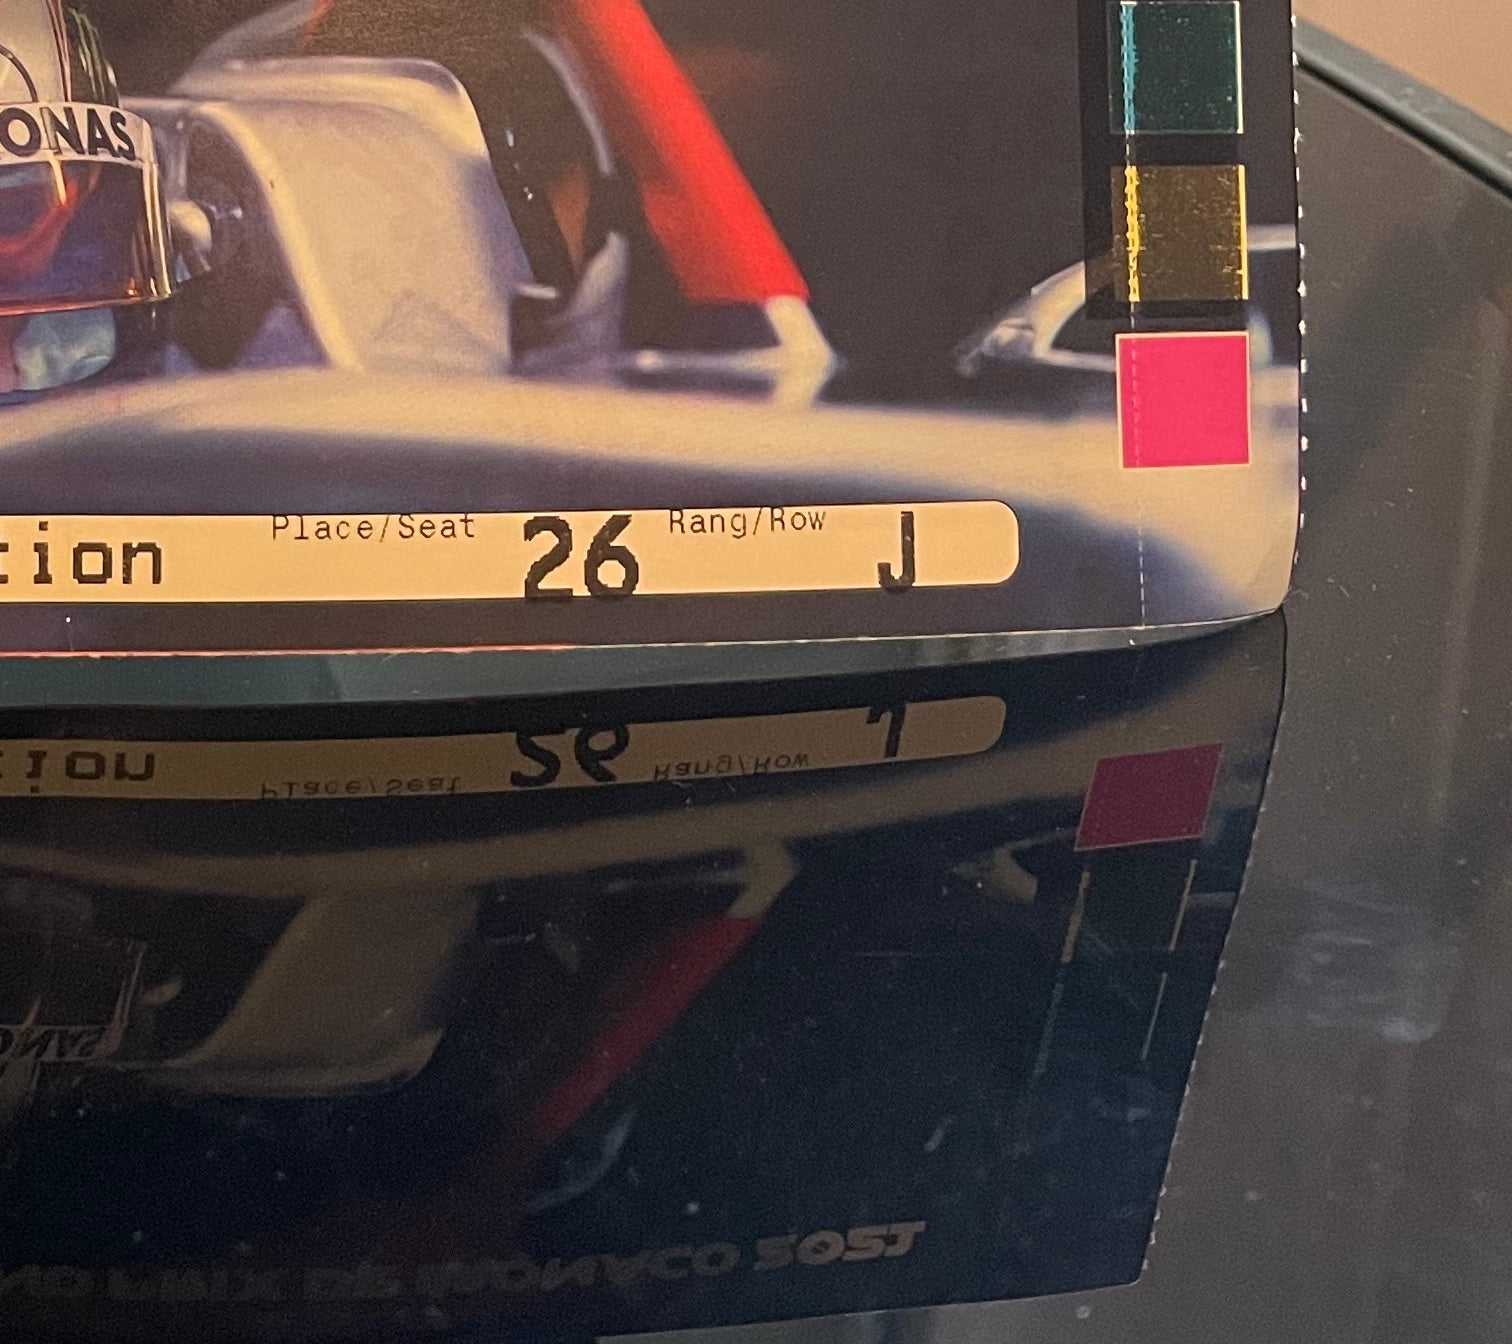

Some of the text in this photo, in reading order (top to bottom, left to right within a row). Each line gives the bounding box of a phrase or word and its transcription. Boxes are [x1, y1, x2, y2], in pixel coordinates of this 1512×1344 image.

[271, 514, 639, 600] Place/Seat 26
[669, 508, 915, 593] Rang/Row J
